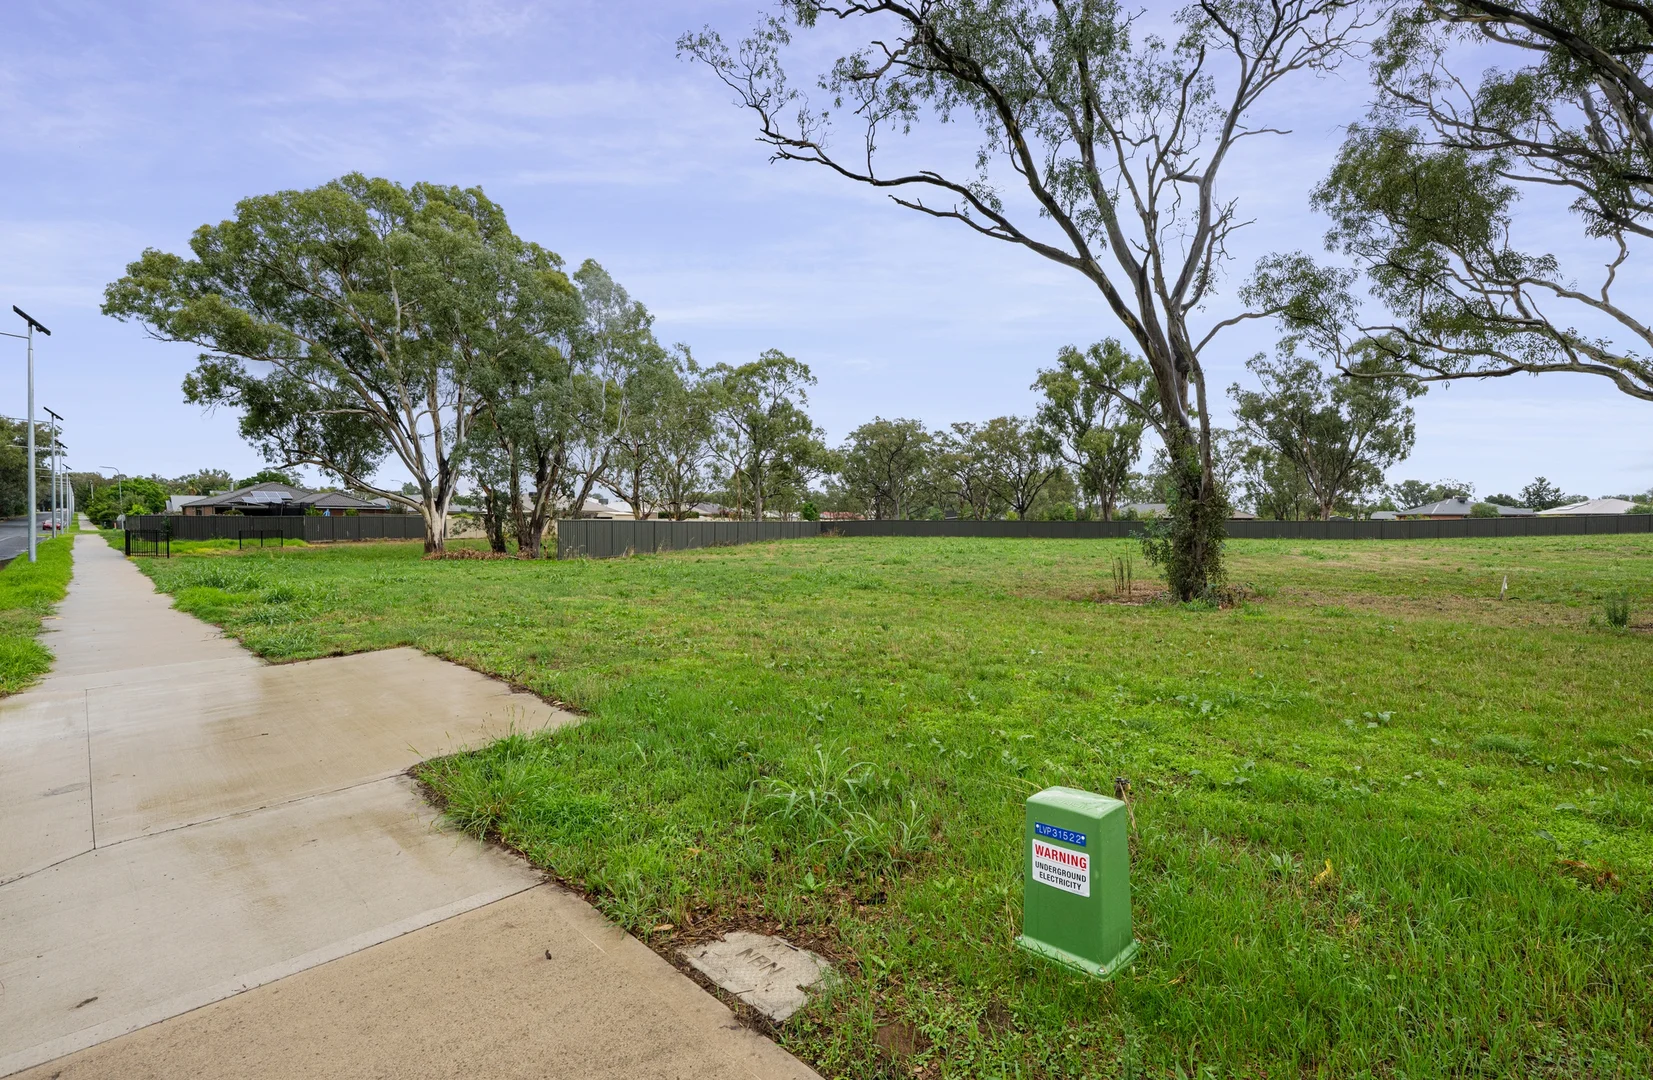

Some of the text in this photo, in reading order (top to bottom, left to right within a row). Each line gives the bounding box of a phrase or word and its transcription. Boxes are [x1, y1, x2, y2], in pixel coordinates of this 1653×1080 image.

[1039, 824, 1081, 844] LVP31522
[1034, 843, 1087, 870] WARNING
[1035, 861, 1087, 883] UNDERGROUND
[1039, 871, 1082, 891] ELECTRICITY
[735, 947, 786, 976] NBN
